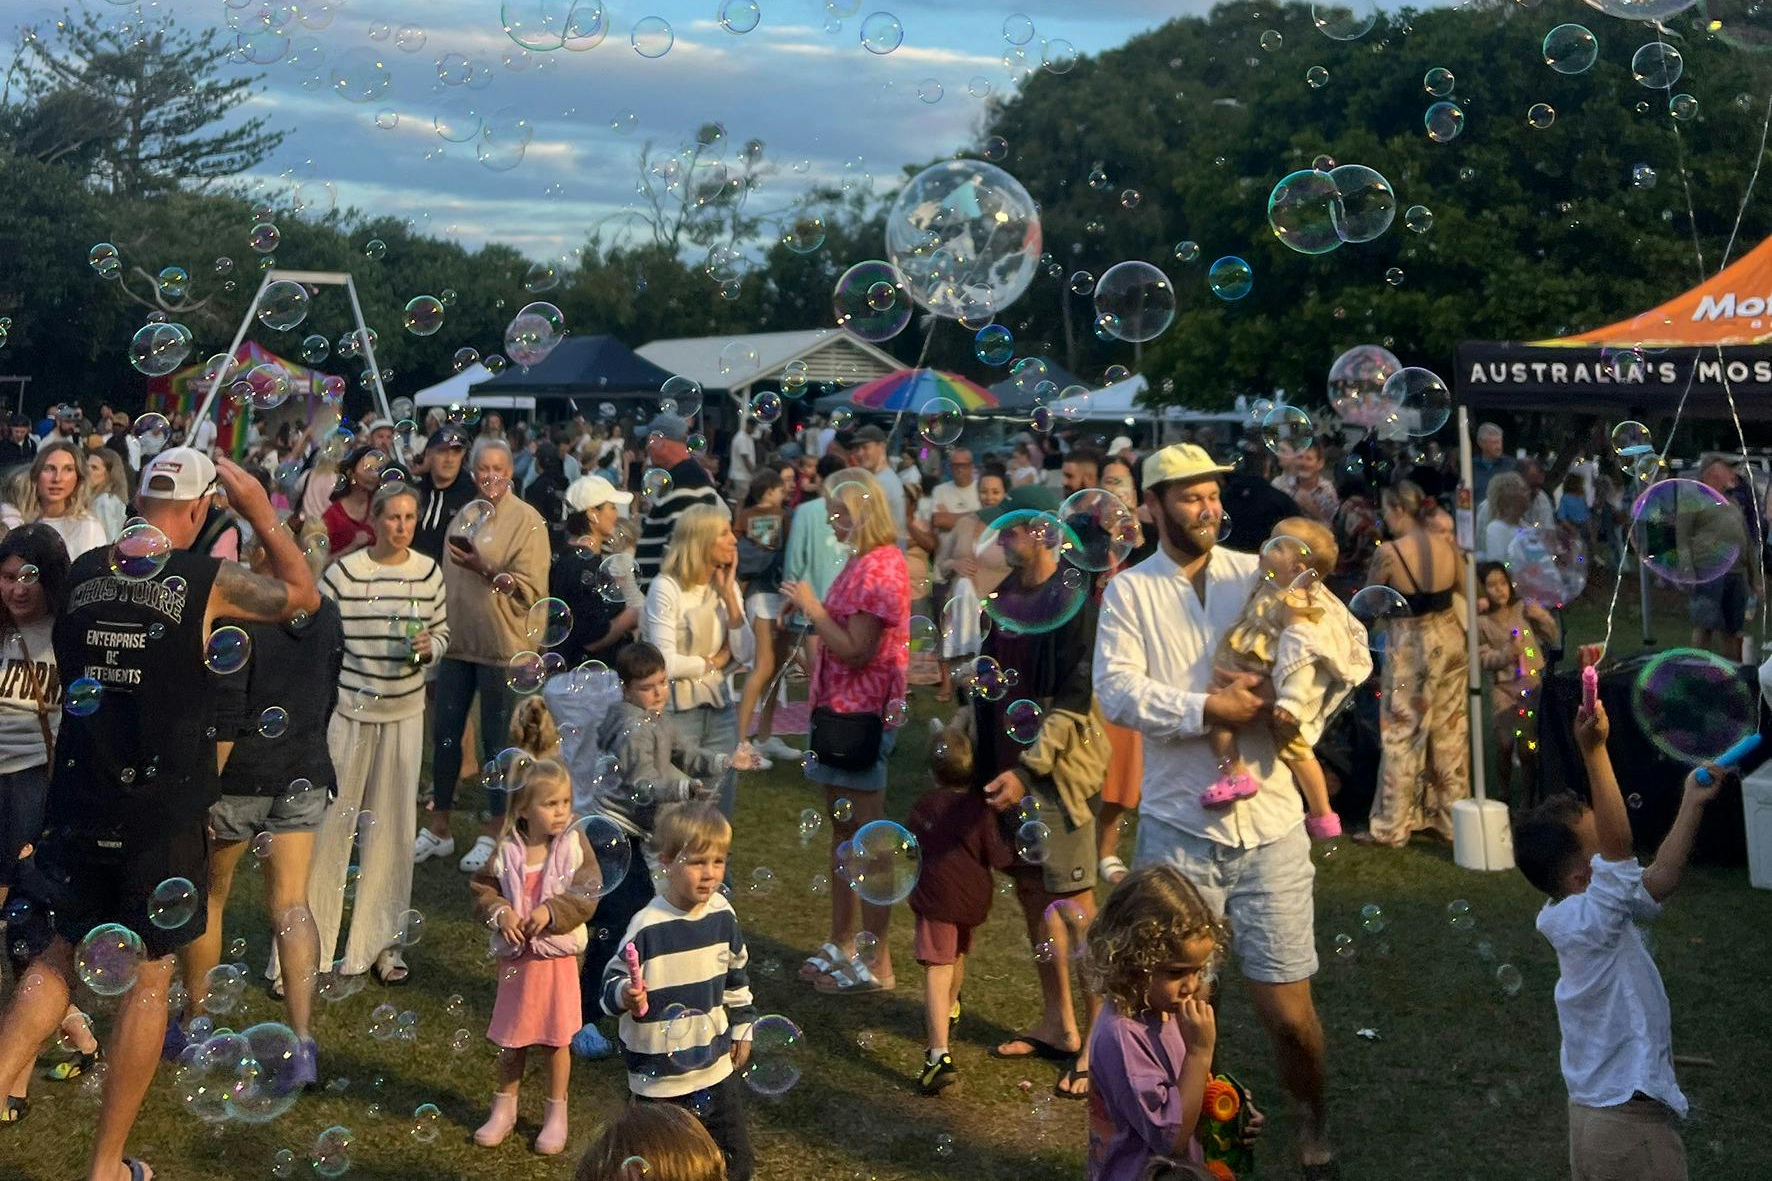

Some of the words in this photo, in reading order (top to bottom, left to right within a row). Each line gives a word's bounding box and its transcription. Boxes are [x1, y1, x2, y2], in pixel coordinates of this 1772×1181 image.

[1470, 362, 1677, 384] AUSTRALIA'S
[86, 629, 147, 648] ENTERPRISE
[84, 665, 142, 685] VETEMENTS
